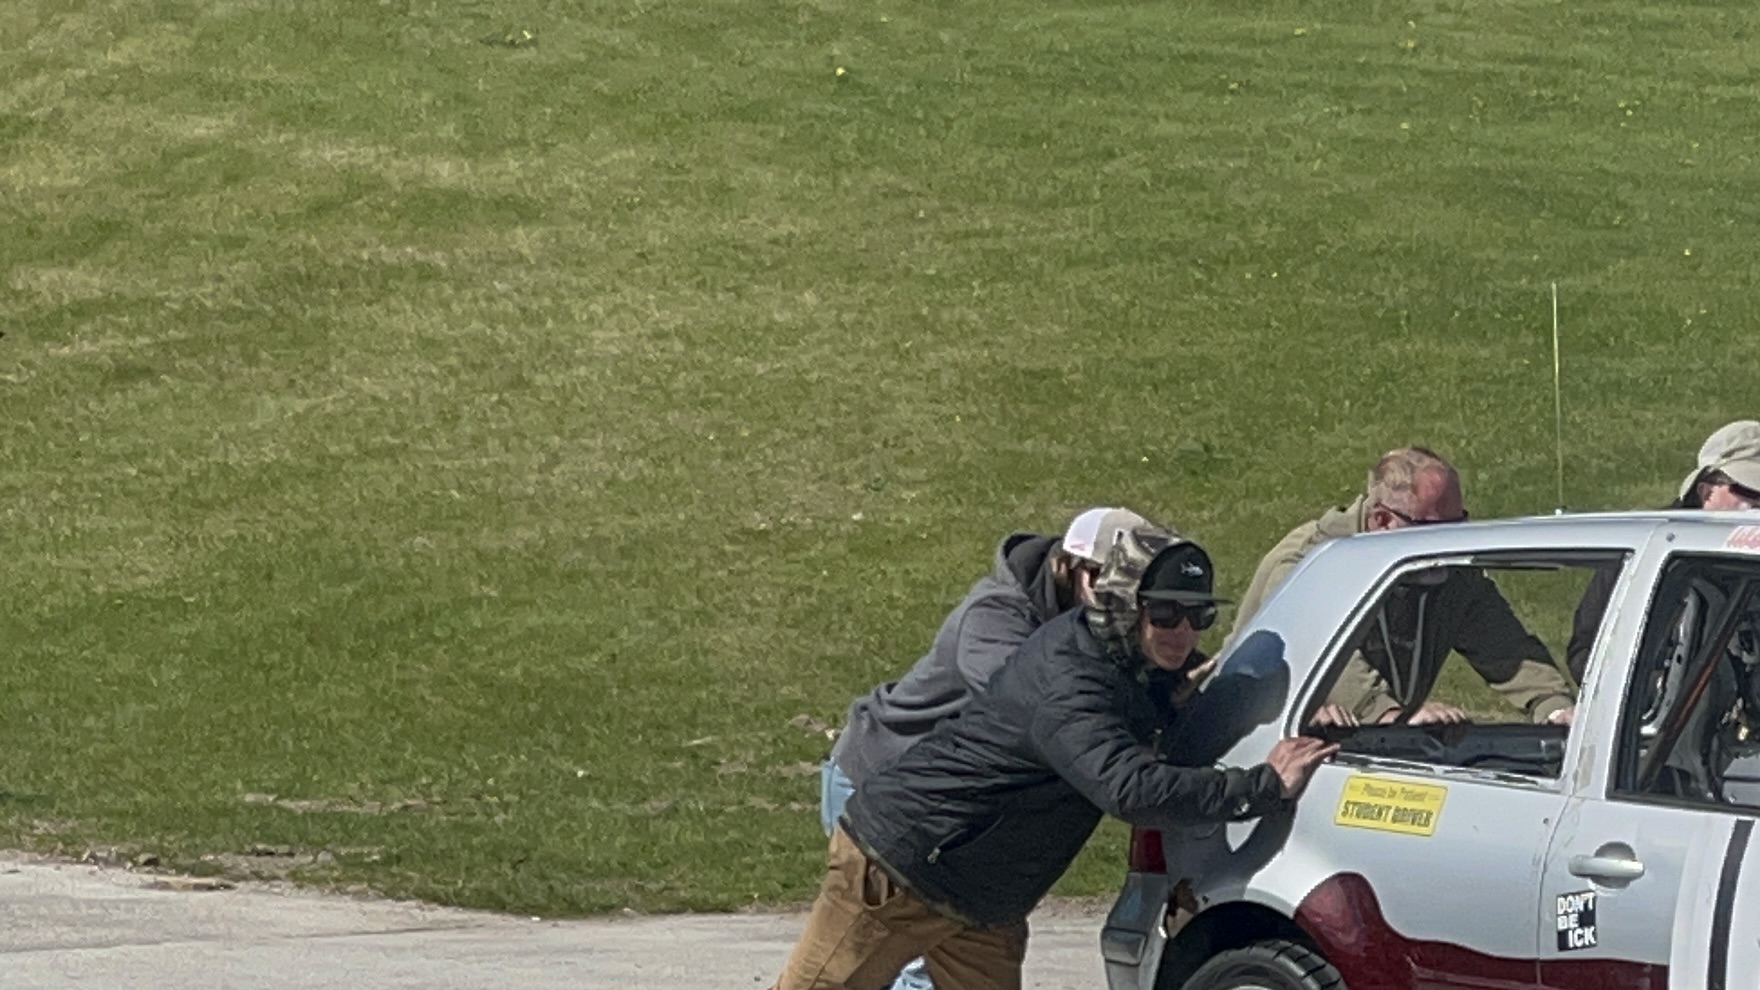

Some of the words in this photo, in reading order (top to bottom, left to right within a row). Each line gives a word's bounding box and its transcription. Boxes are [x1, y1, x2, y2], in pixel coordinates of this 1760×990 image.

[1341, 800, 1393, 822] STUDENT
[1557, 913, 1579, 930] BE
[1568, 926, 1597, 948] ICK
